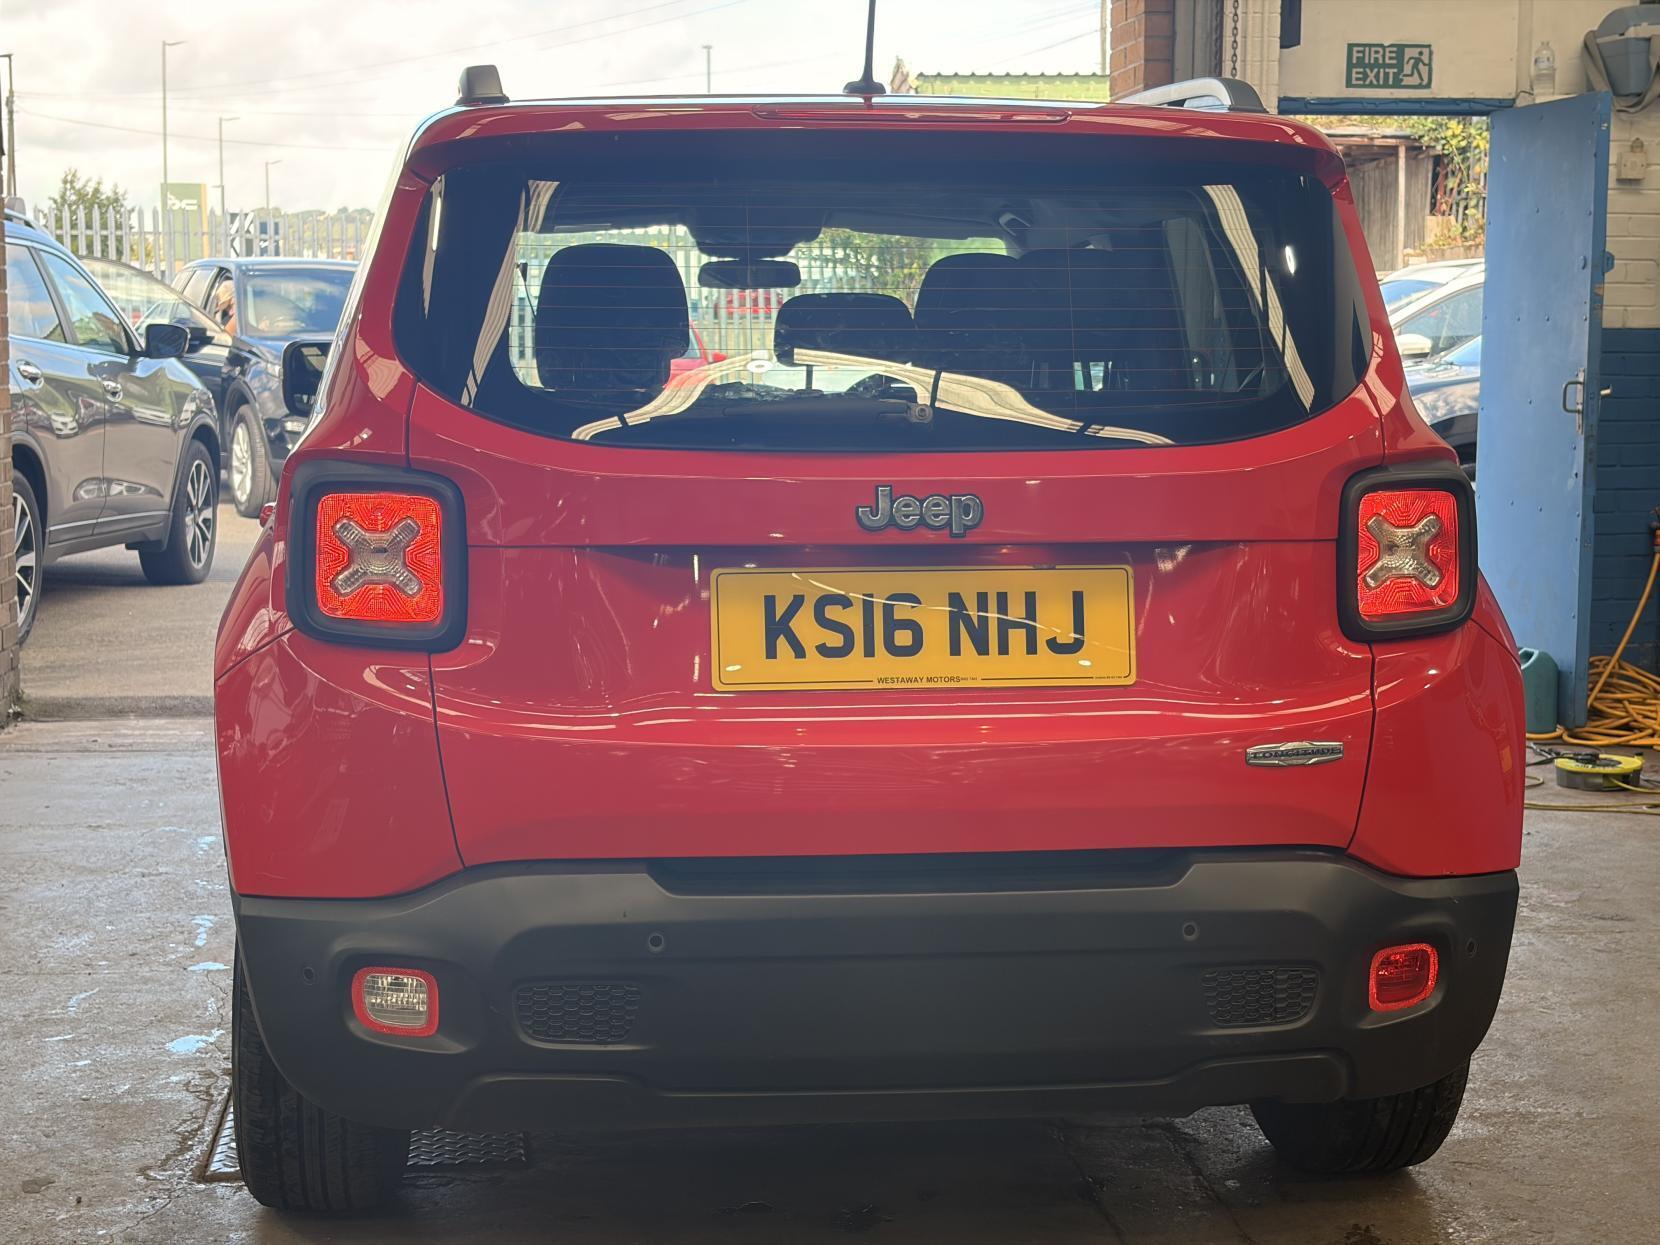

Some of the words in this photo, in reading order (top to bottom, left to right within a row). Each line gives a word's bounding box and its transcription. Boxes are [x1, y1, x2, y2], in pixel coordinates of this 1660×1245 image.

[1352, 47, 1397, 64] FIRE
[1351, 68, 1398, 85] EXIT
[857, 486, 982, 536] Jeep
[763, 592, 924, 659] KS16
[947, 590, 1086, 656] NHJ
[877, 676, 924, 684] WESTAWAY
[926, 675, 961, 683] MOTORS
